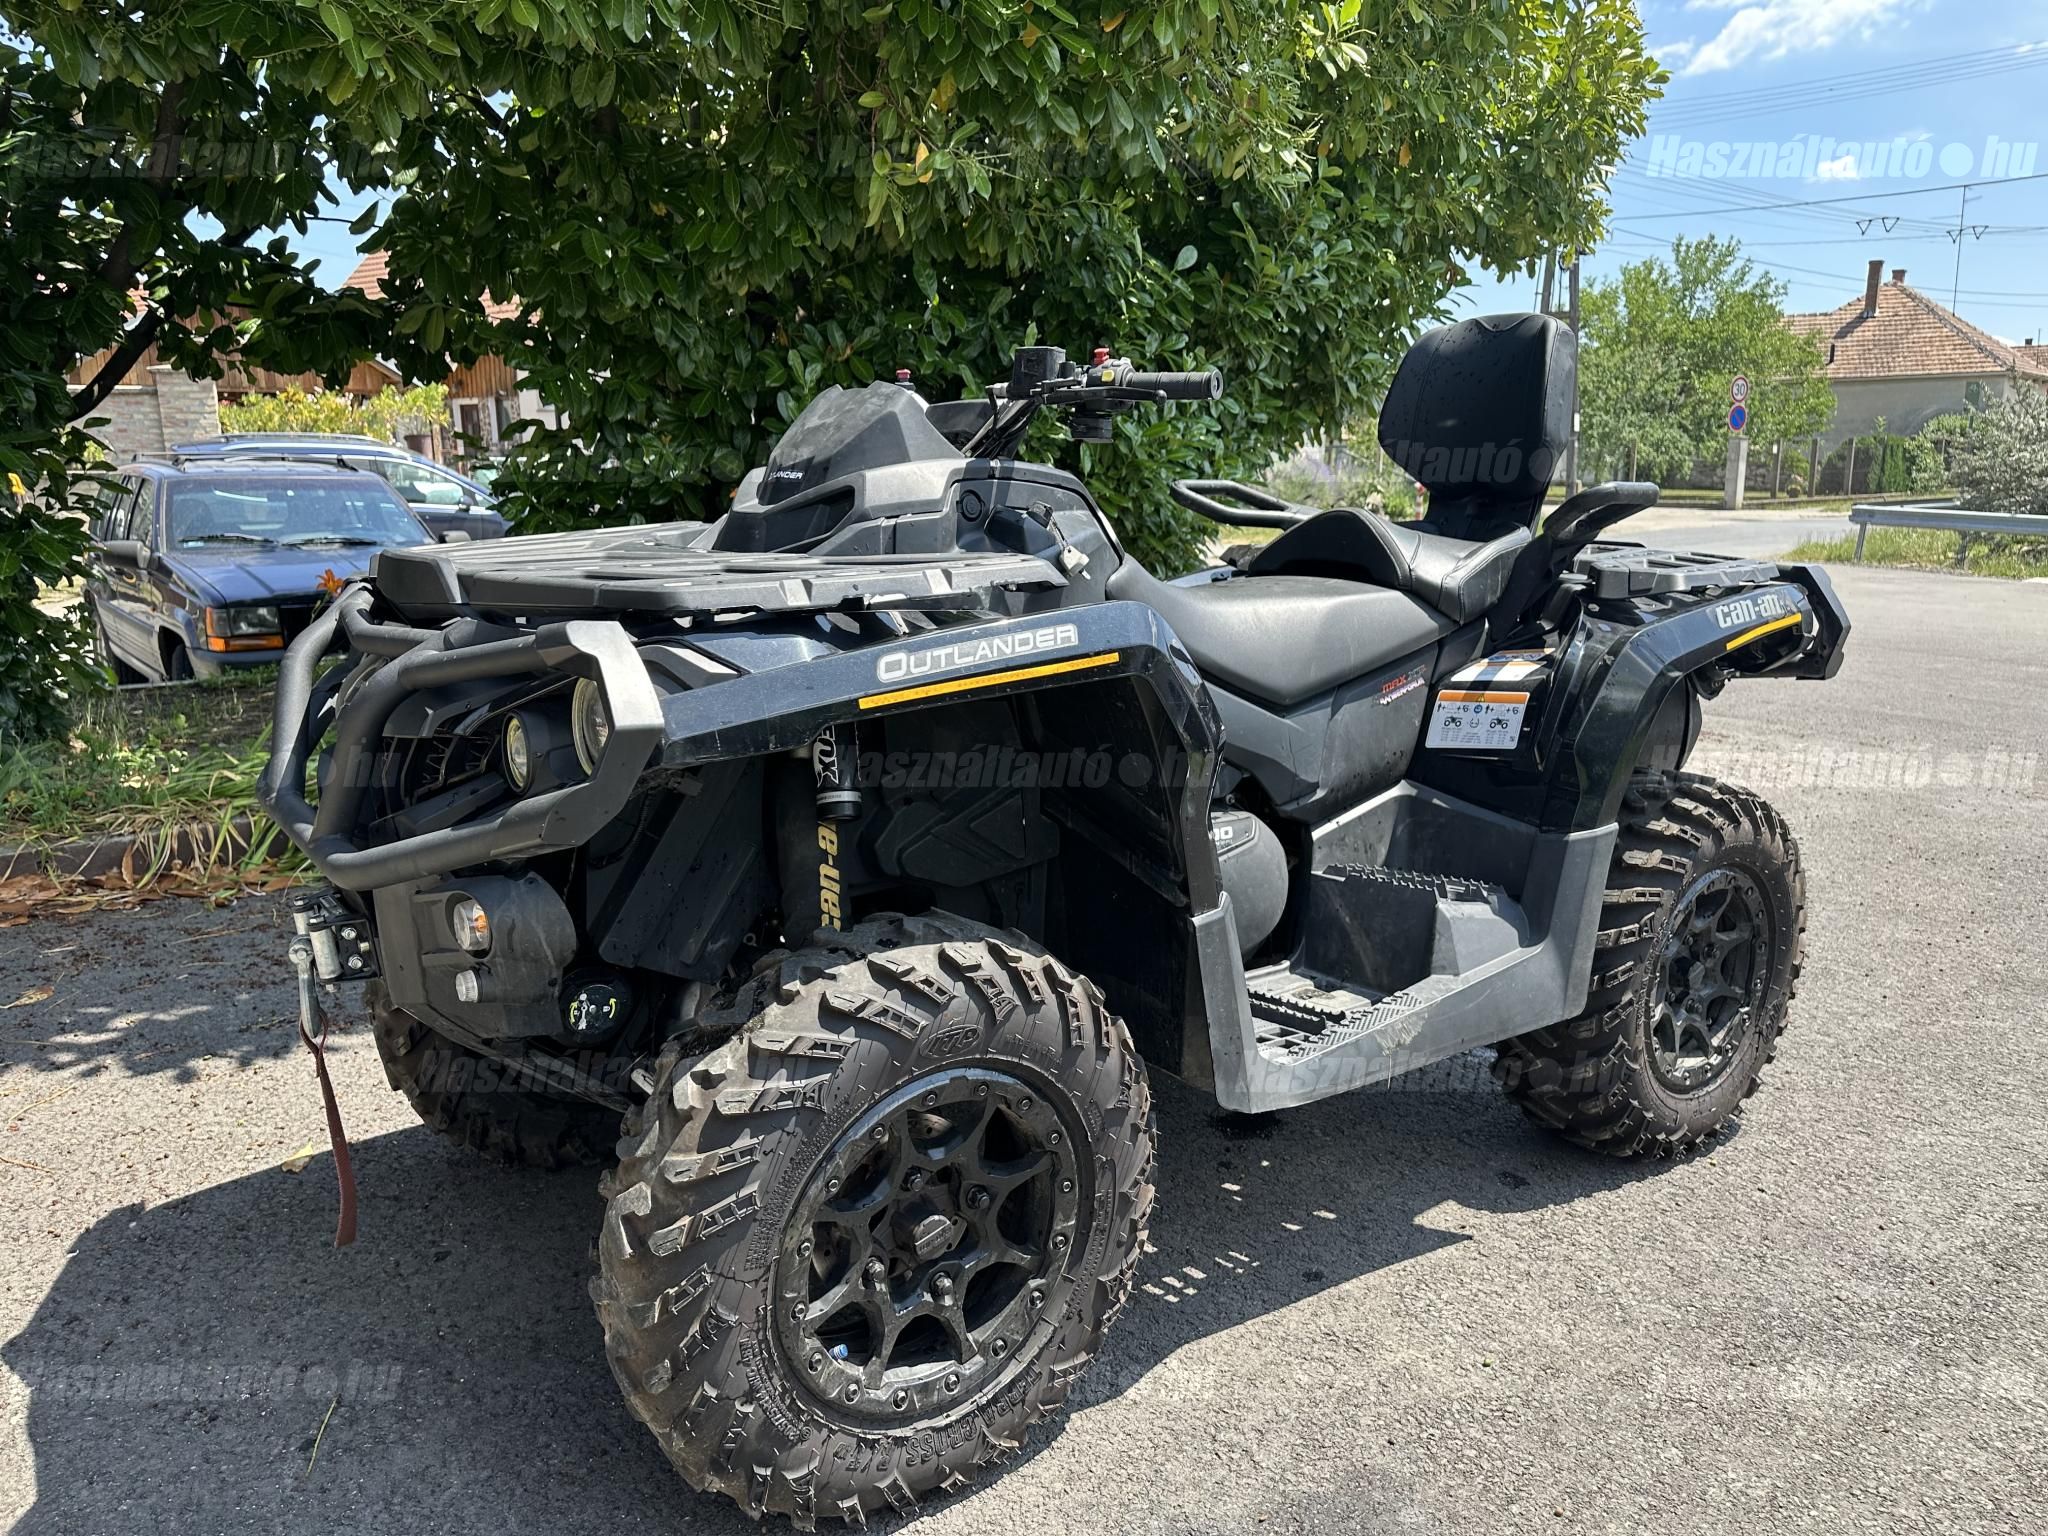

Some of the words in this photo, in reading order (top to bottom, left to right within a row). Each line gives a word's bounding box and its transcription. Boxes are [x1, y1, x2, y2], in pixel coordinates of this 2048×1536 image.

[1734, 383, 1746, 397] 30
[878, 624, 1077, 682] OUTLANDER
[905, 1412, 977, 1466] CROSS
